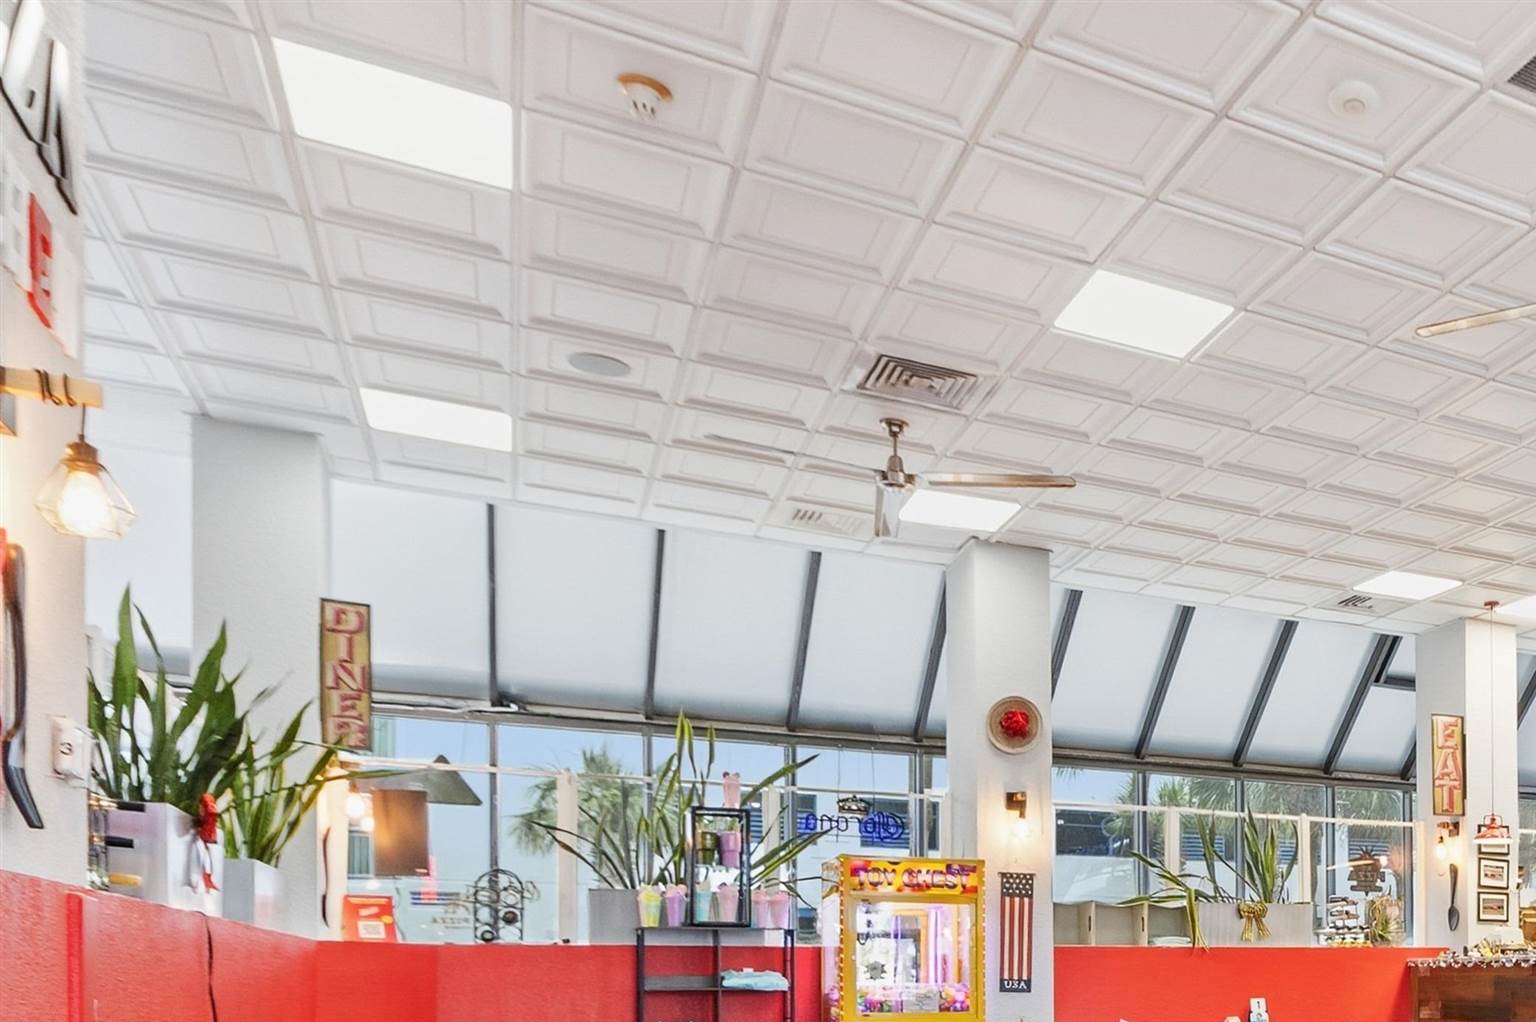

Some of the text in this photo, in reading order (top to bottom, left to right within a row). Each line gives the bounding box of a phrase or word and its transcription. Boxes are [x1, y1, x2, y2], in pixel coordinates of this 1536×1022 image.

[323, 607, 369, 748] DINER
[1434, 718, 1463, 812] EAT
[856, 866, 970, 889] TOY CHEST
[1004, 981, 1027, 989] USA
